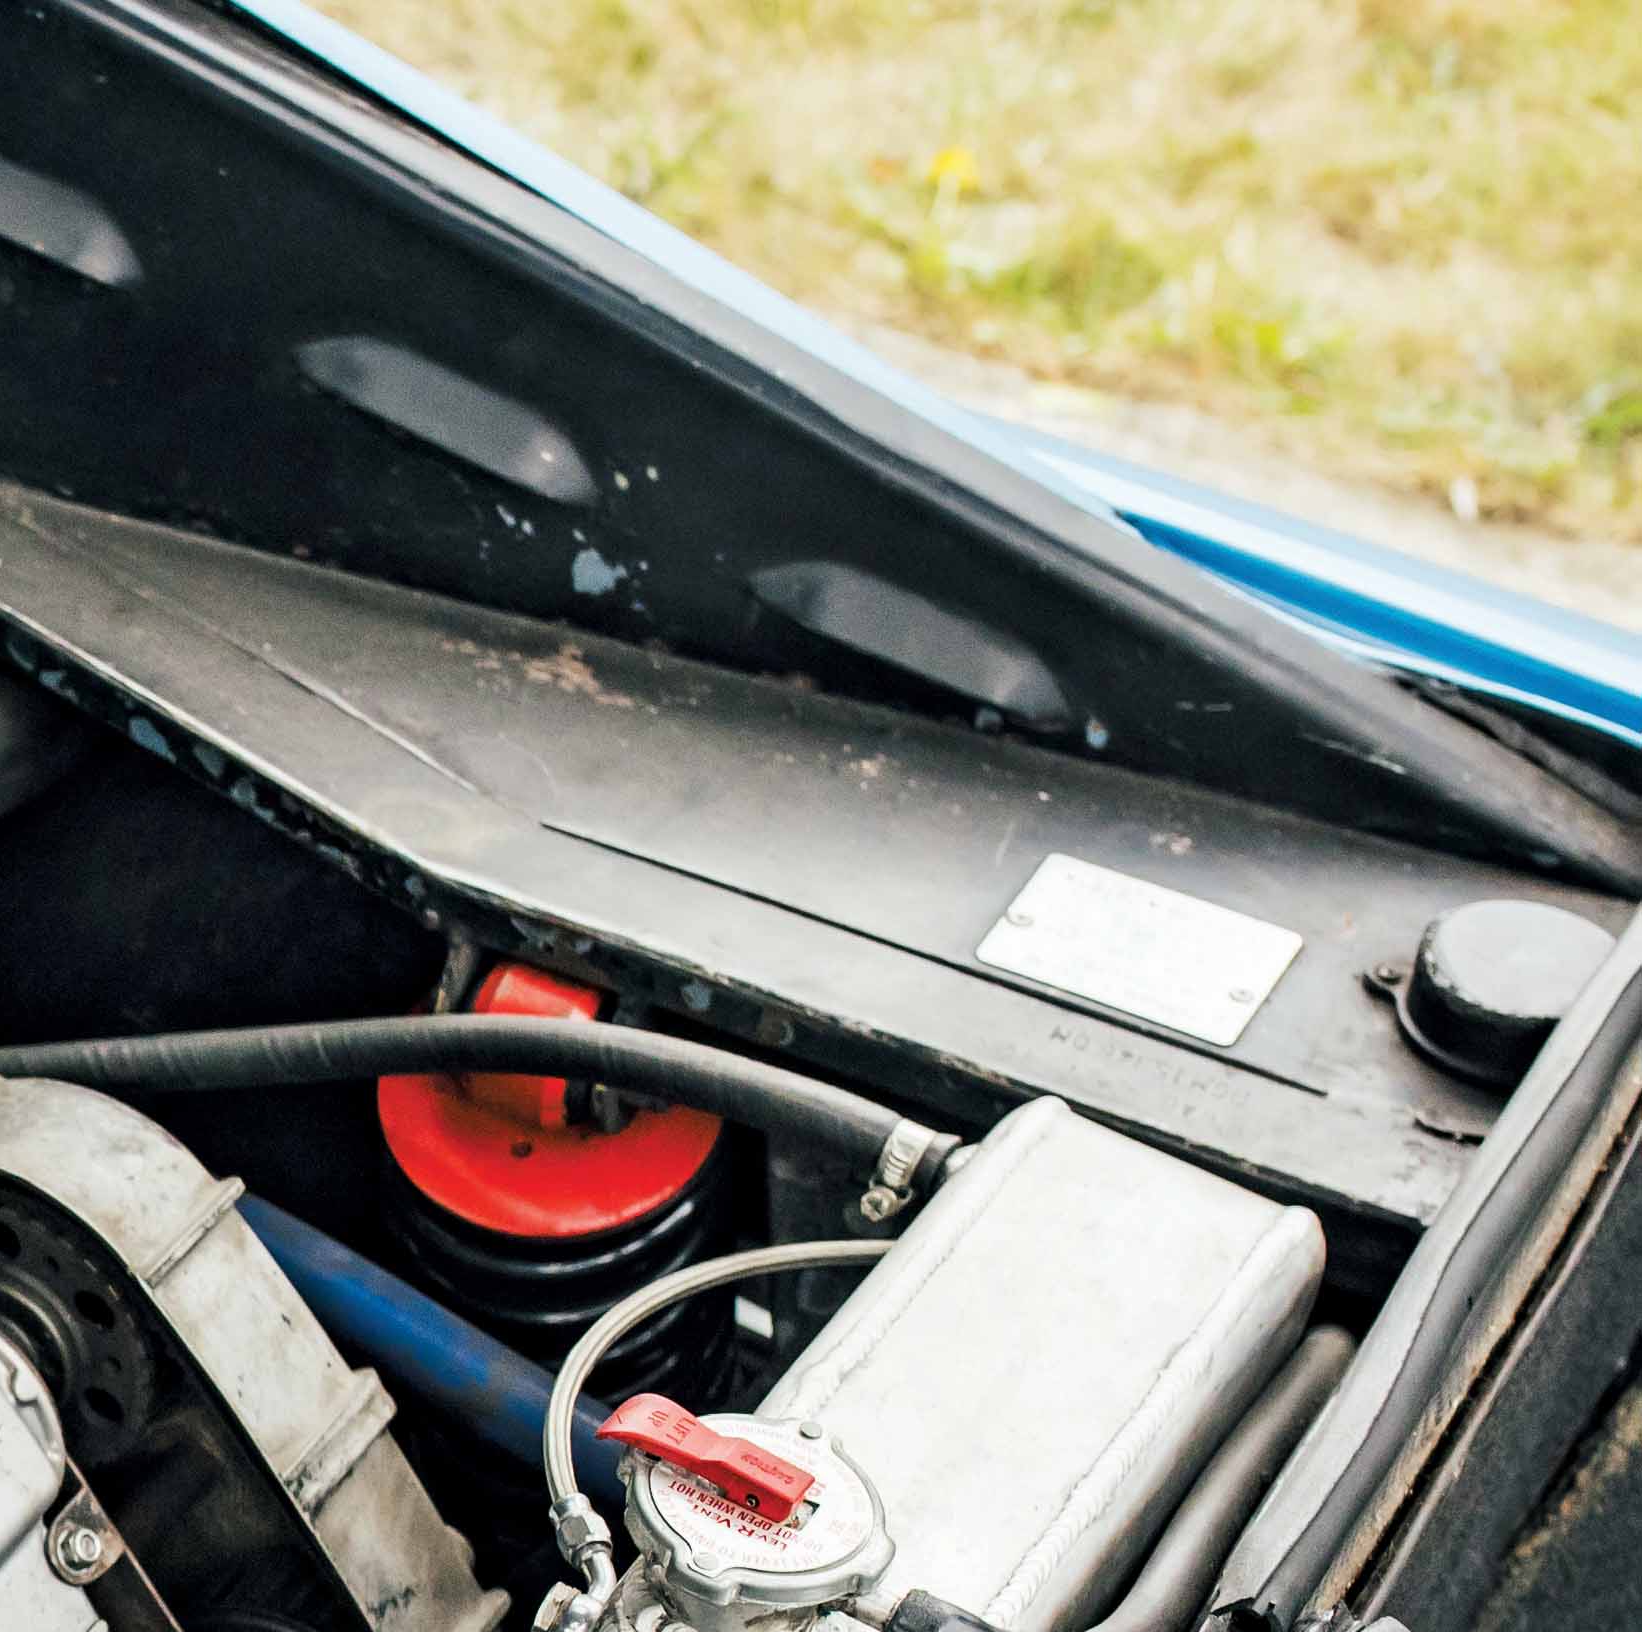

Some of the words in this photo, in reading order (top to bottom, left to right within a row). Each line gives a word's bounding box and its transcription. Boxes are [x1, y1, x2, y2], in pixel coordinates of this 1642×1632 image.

[667, 1480, 696, 1497] HOT
[697, 1490, 736, 1516] WHEN
[736, 1510, 773, 1531] OPEN
